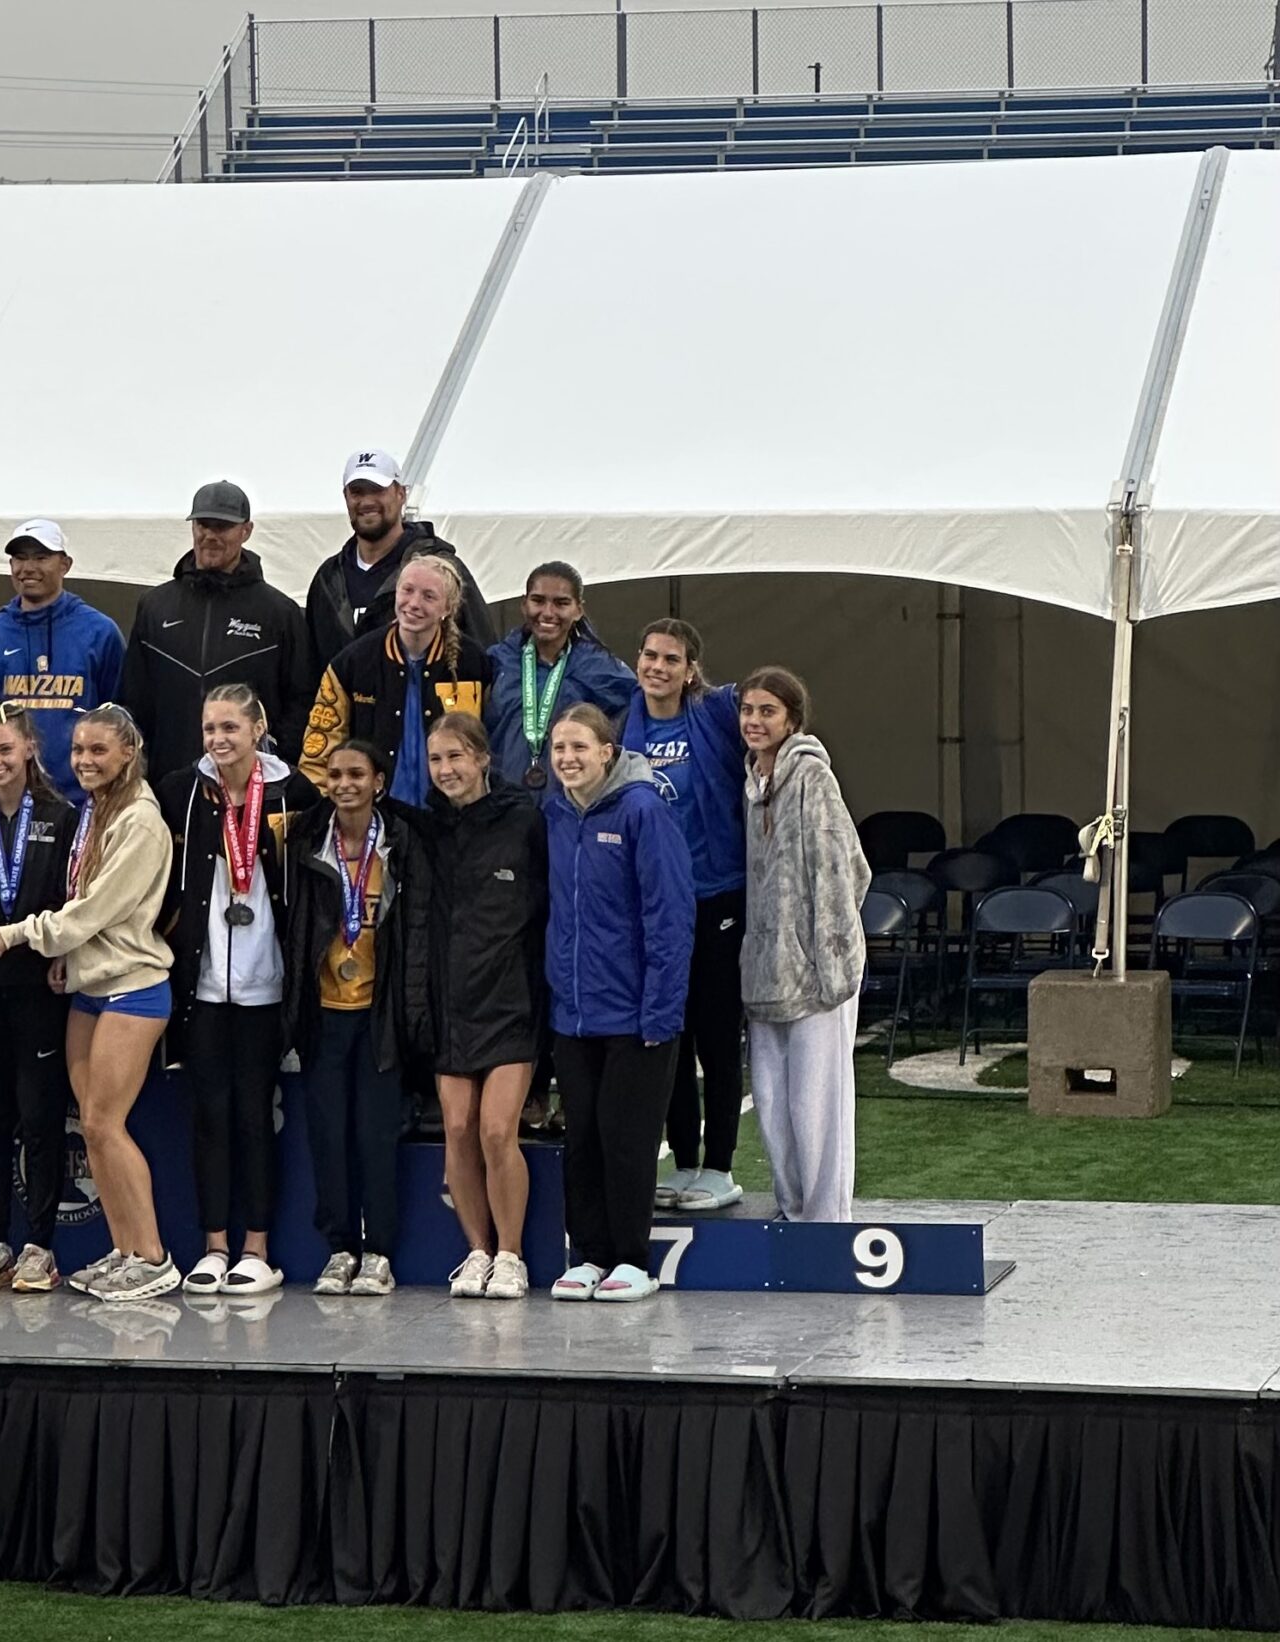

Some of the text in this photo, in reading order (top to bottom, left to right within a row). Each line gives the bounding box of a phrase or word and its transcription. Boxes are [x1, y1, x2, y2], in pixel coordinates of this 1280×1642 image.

[358, 453, 377, 463] W
[3, 674, 85, 697] WAYZATA
[649, 1227, 694, 1285] 7
[853, 1228, 904, 1288] 9
